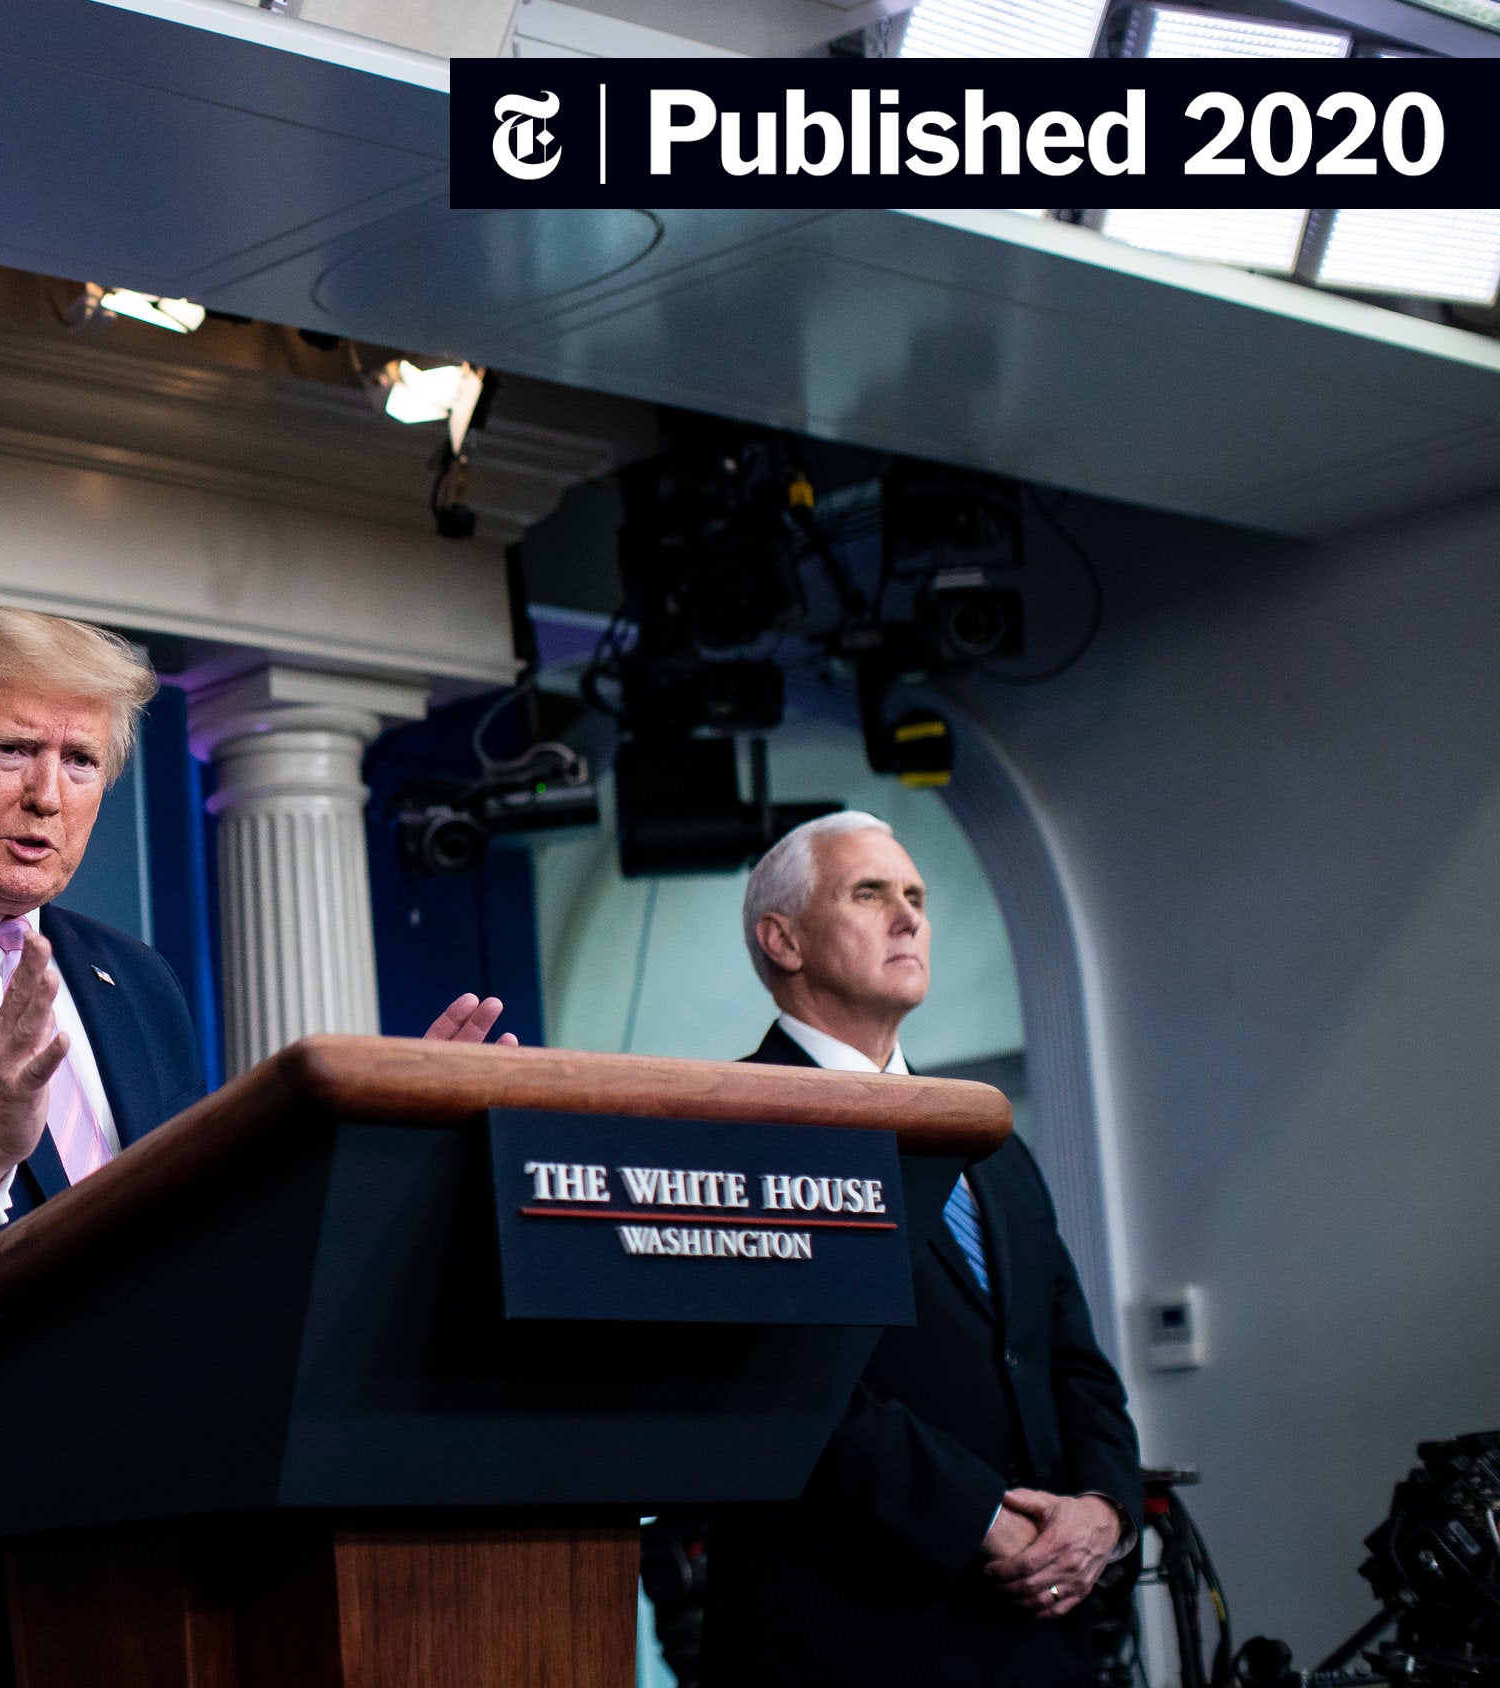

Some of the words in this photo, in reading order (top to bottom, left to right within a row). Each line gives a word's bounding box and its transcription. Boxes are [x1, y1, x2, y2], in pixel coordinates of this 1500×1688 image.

[524, 1162, 610, 1201] THE
[617, 1167, 749, 1207] WHITE
[760, 1175, 886, 1213] HOUSE
[614, 1226, 812, 1259] WASHINGTON
